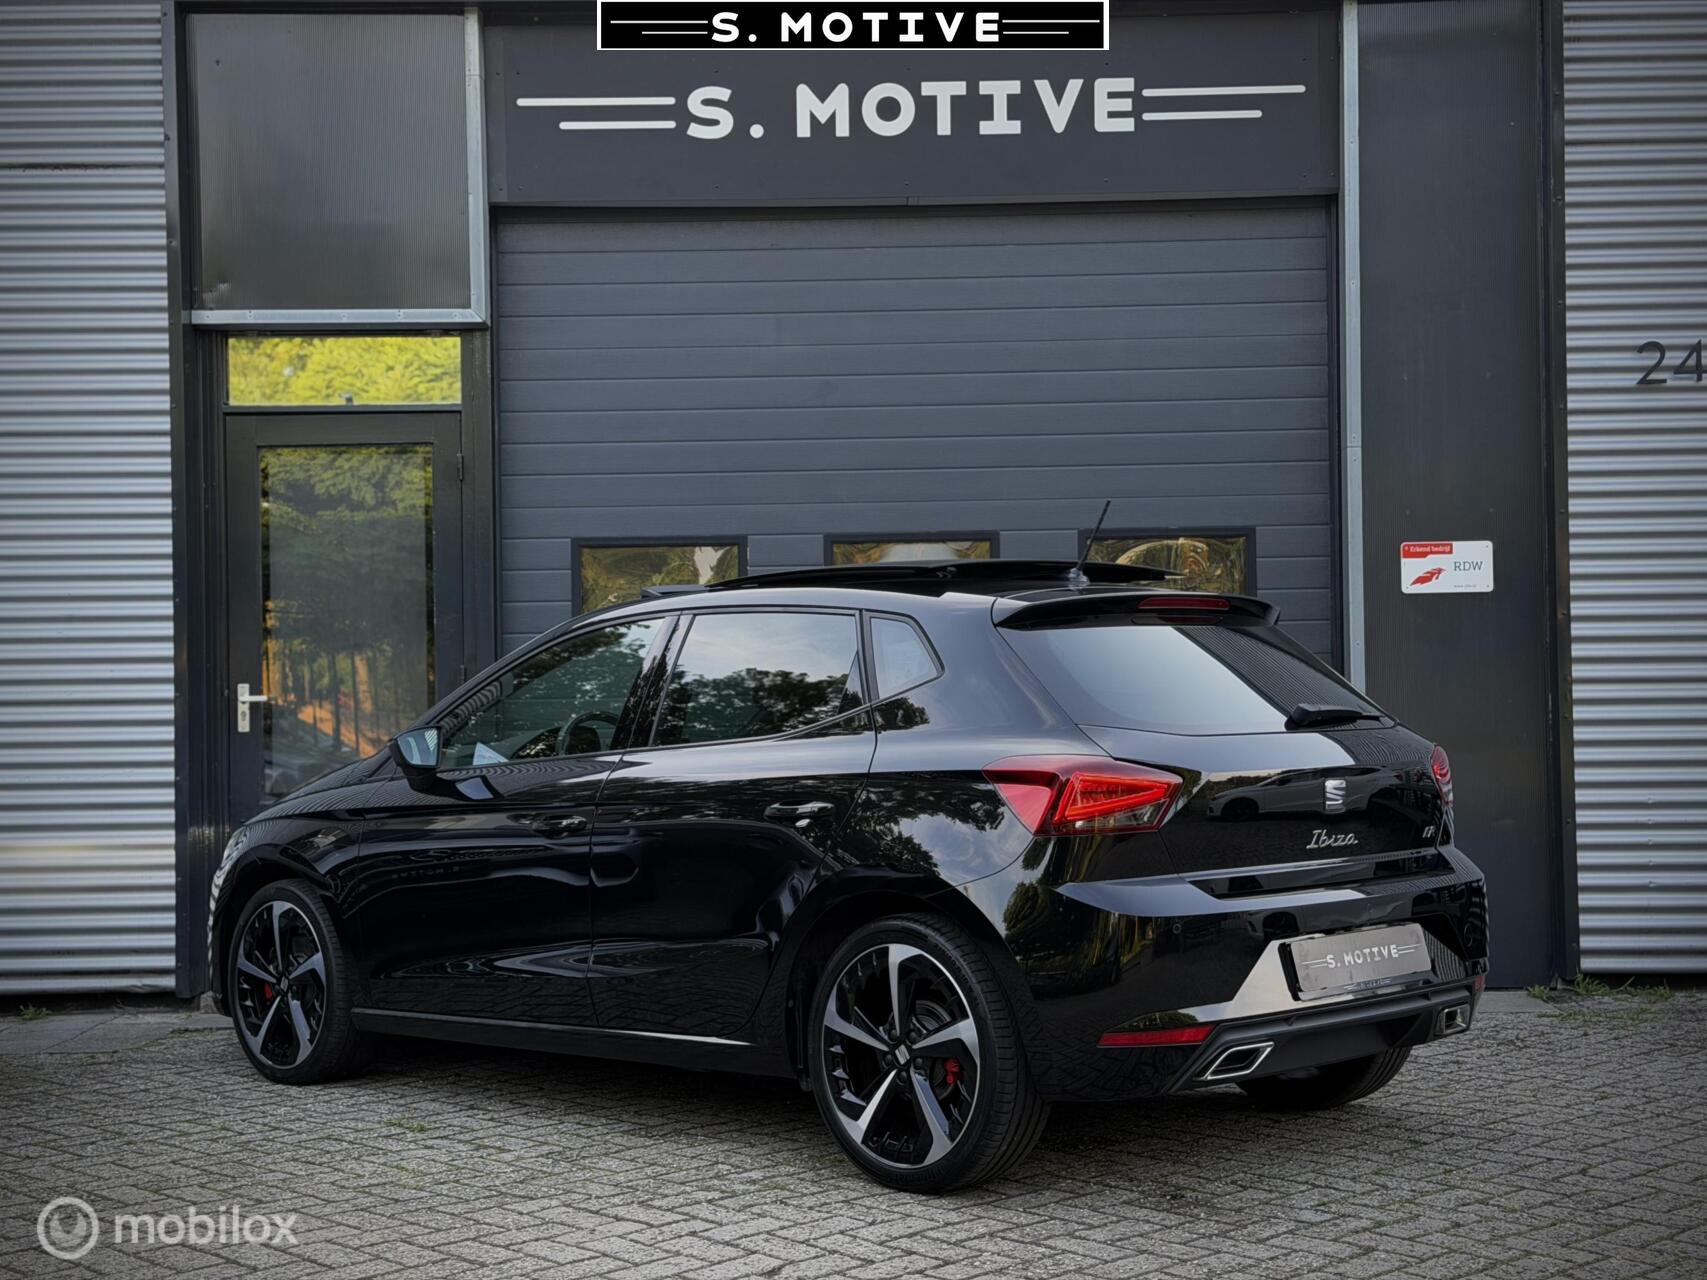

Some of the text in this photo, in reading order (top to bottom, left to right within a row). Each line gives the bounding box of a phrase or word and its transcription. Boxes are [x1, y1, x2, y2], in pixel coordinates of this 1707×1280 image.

[686, 77, 1136, 140] S. MOTIVE
[1636, 339, 1707, 385] 24
[1453, 561, 1483, 572] RDW
[1306, 828, 1359, 850] Ibiza
[1326, 944, 1399, 969] S. MOTIVE
